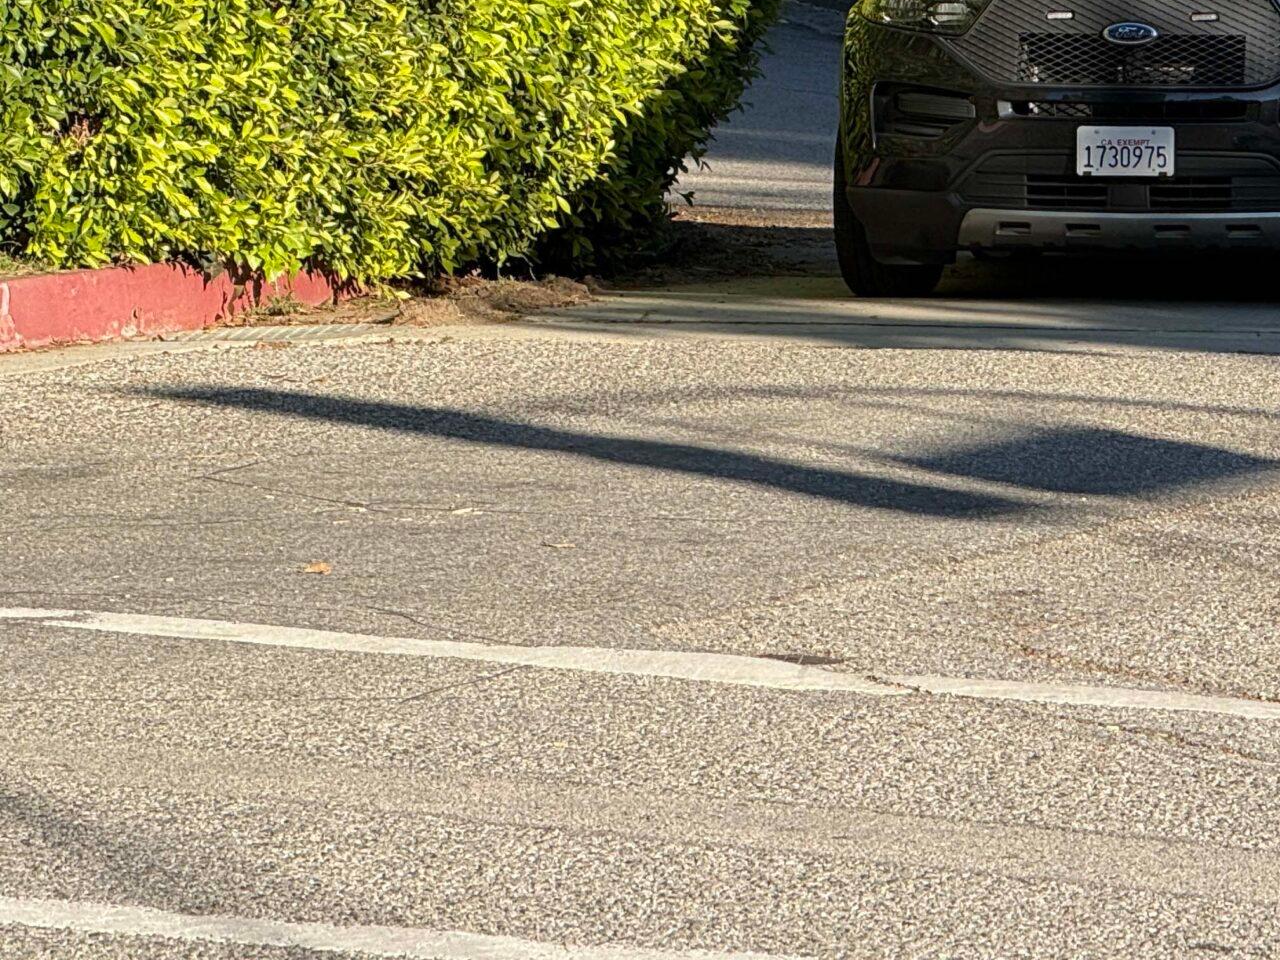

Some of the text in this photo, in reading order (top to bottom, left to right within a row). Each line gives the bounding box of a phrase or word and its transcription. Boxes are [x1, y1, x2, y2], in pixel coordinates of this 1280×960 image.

[1100, 139, 1151, 147] CA EXEMPT
[1083, 145, 1167, 168] 1730975
